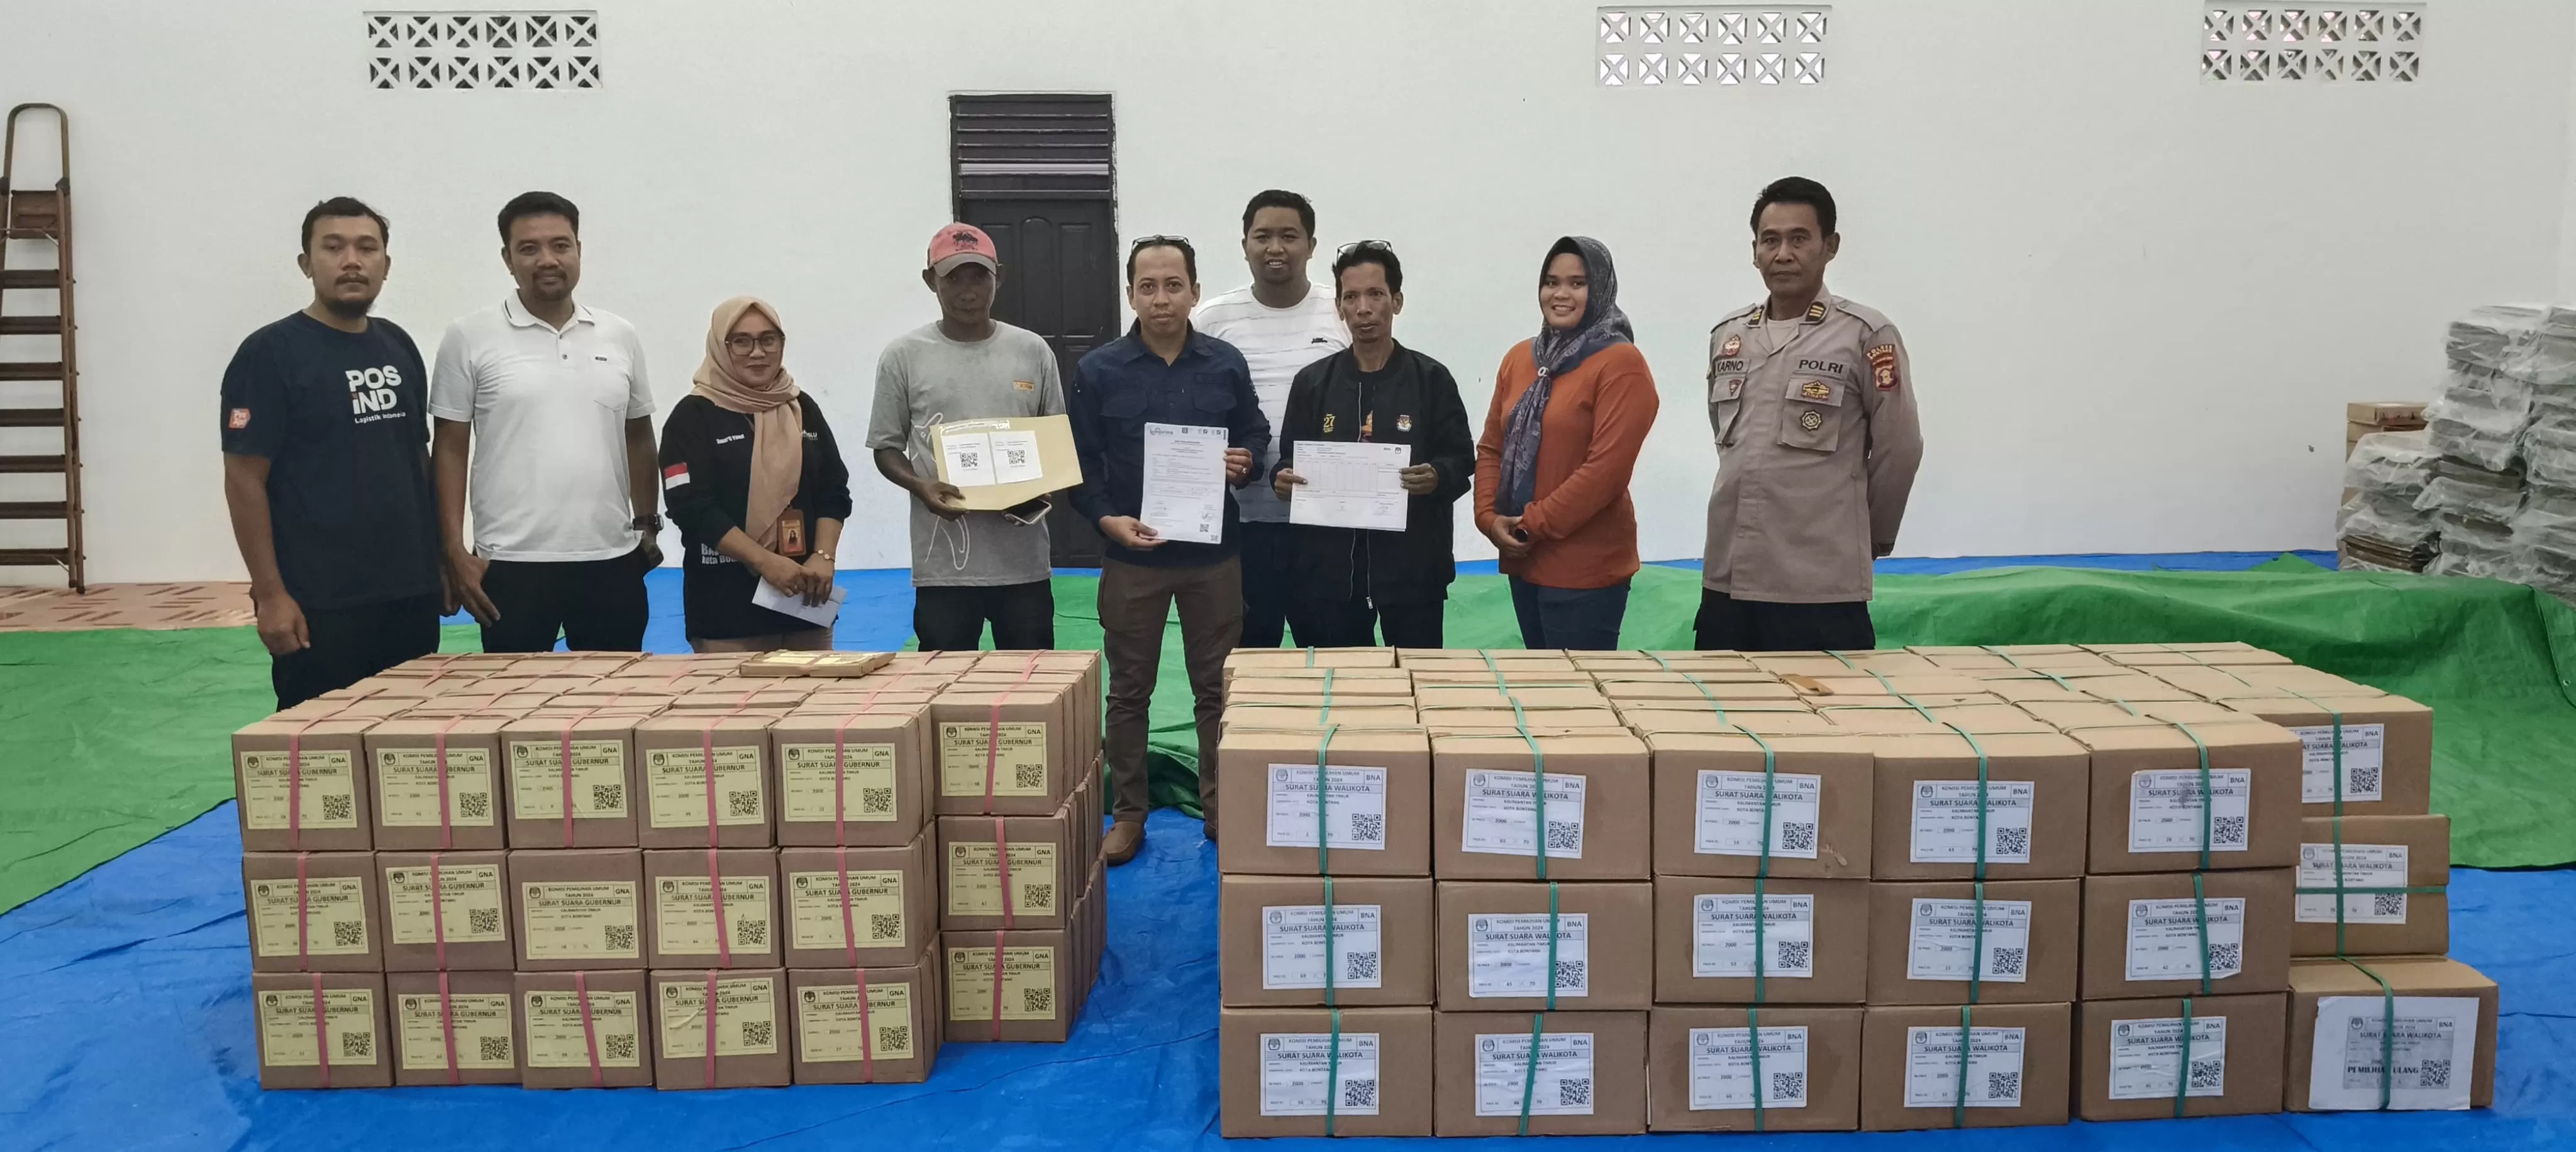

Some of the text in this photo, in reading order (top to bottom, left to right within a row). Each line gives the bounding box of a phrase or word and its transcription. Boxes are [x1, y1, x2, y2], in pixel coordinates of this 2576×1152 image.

[1799, 359, 1843, 374] POLRI
[345, 365, 402, 392] POS
[354, 414, 382, 424] Logistik
[1323, 416, 1336, 428] 27
[1482, 788, 1505, 796] SURAT
